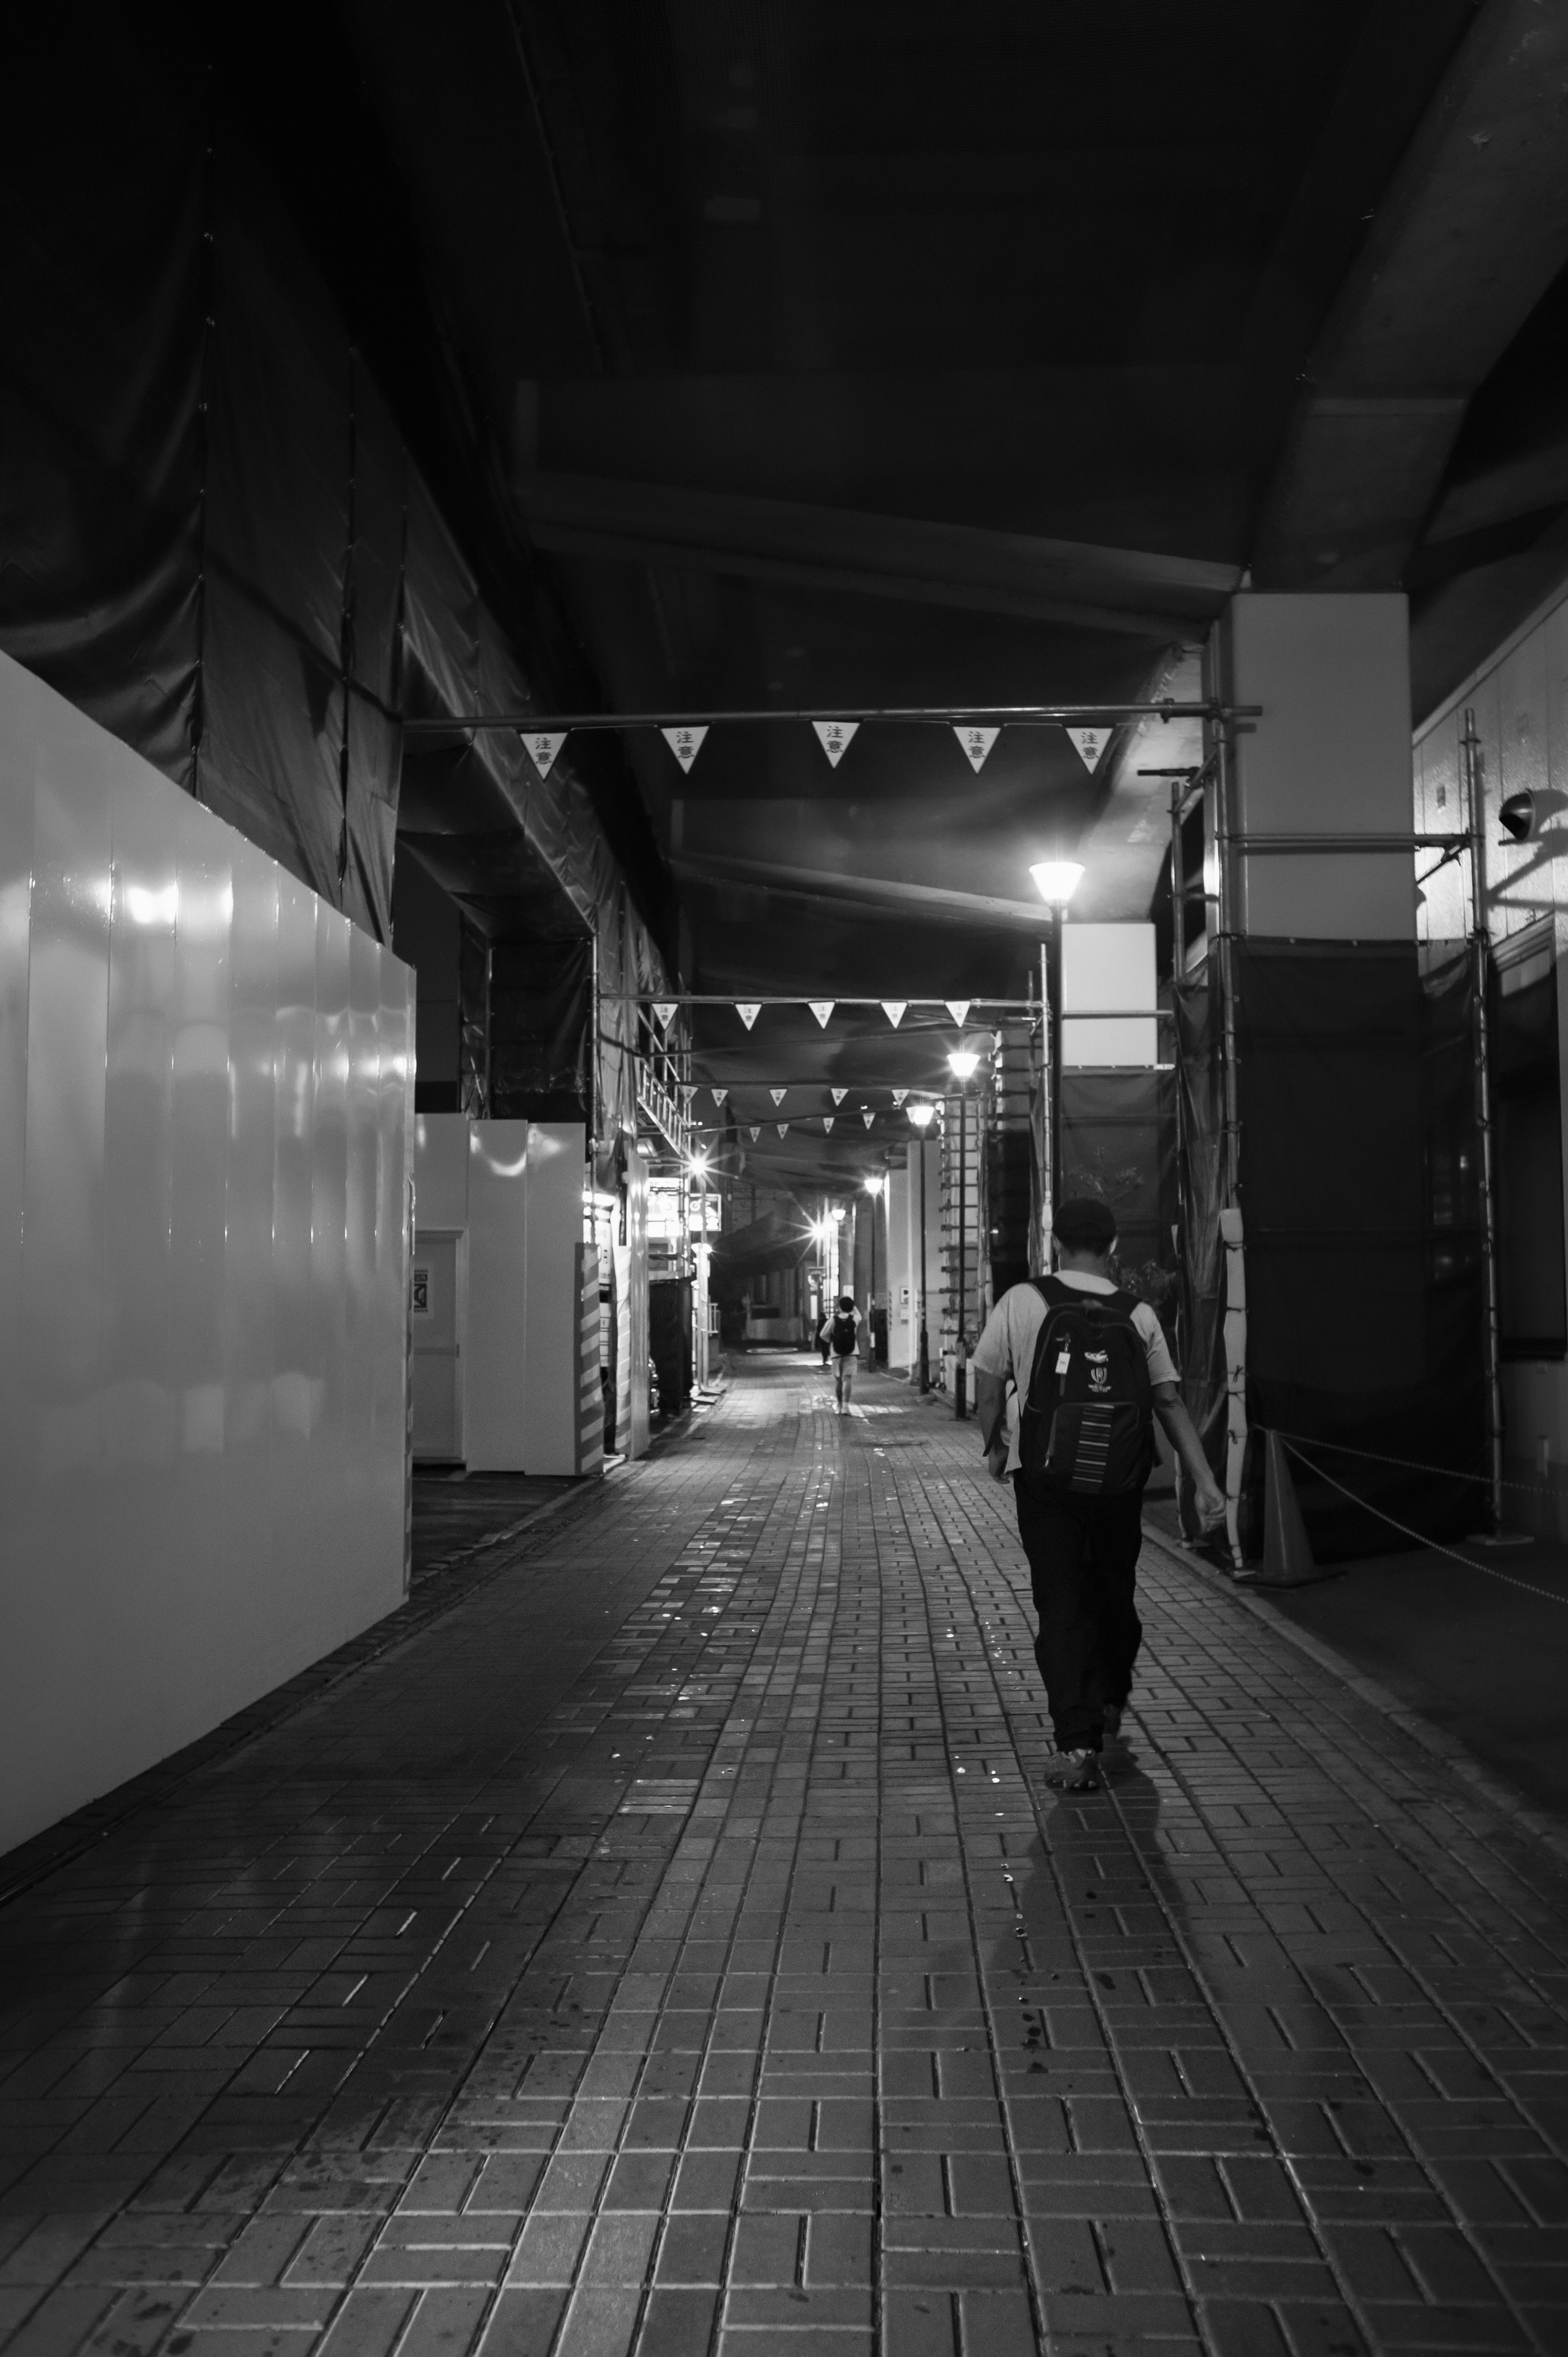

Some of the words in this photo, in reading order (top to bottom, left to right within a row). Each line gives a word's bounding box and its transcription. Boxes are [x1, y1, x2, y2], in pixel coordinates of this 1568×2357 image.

[535, 737, 552, 765] 注意
[676, 731, 695, 759] 注意
[826, 725, 844, 753] 注意
[968, 731, 985, 759] 注意
[1081, 732, 1099, 759] 注意
